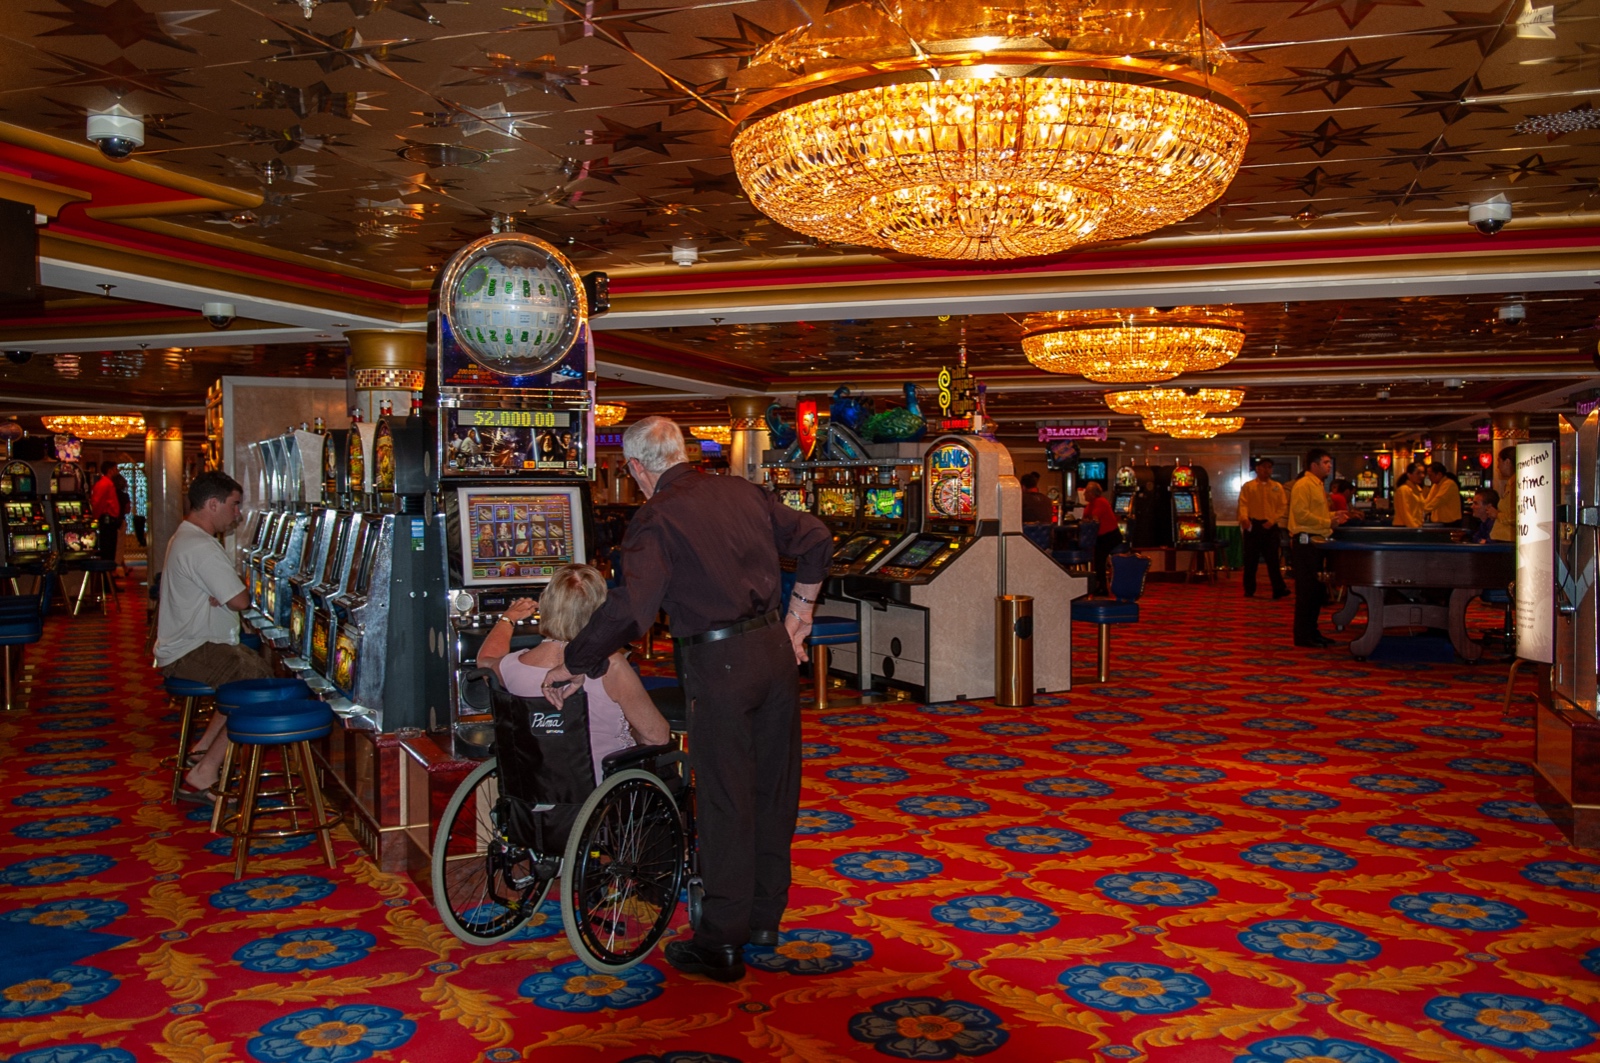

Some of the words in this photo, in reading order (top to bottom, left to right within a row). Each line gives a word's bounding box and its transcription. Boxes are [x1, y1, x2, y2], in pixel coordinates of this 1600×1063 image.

[474, 410, 555, 427] $2,000.00
[1046, 427, 1099, 436] BLACKJACK
[595, 434, 621, 443] OKER
[932, 448, 969, 468] PLINKO
